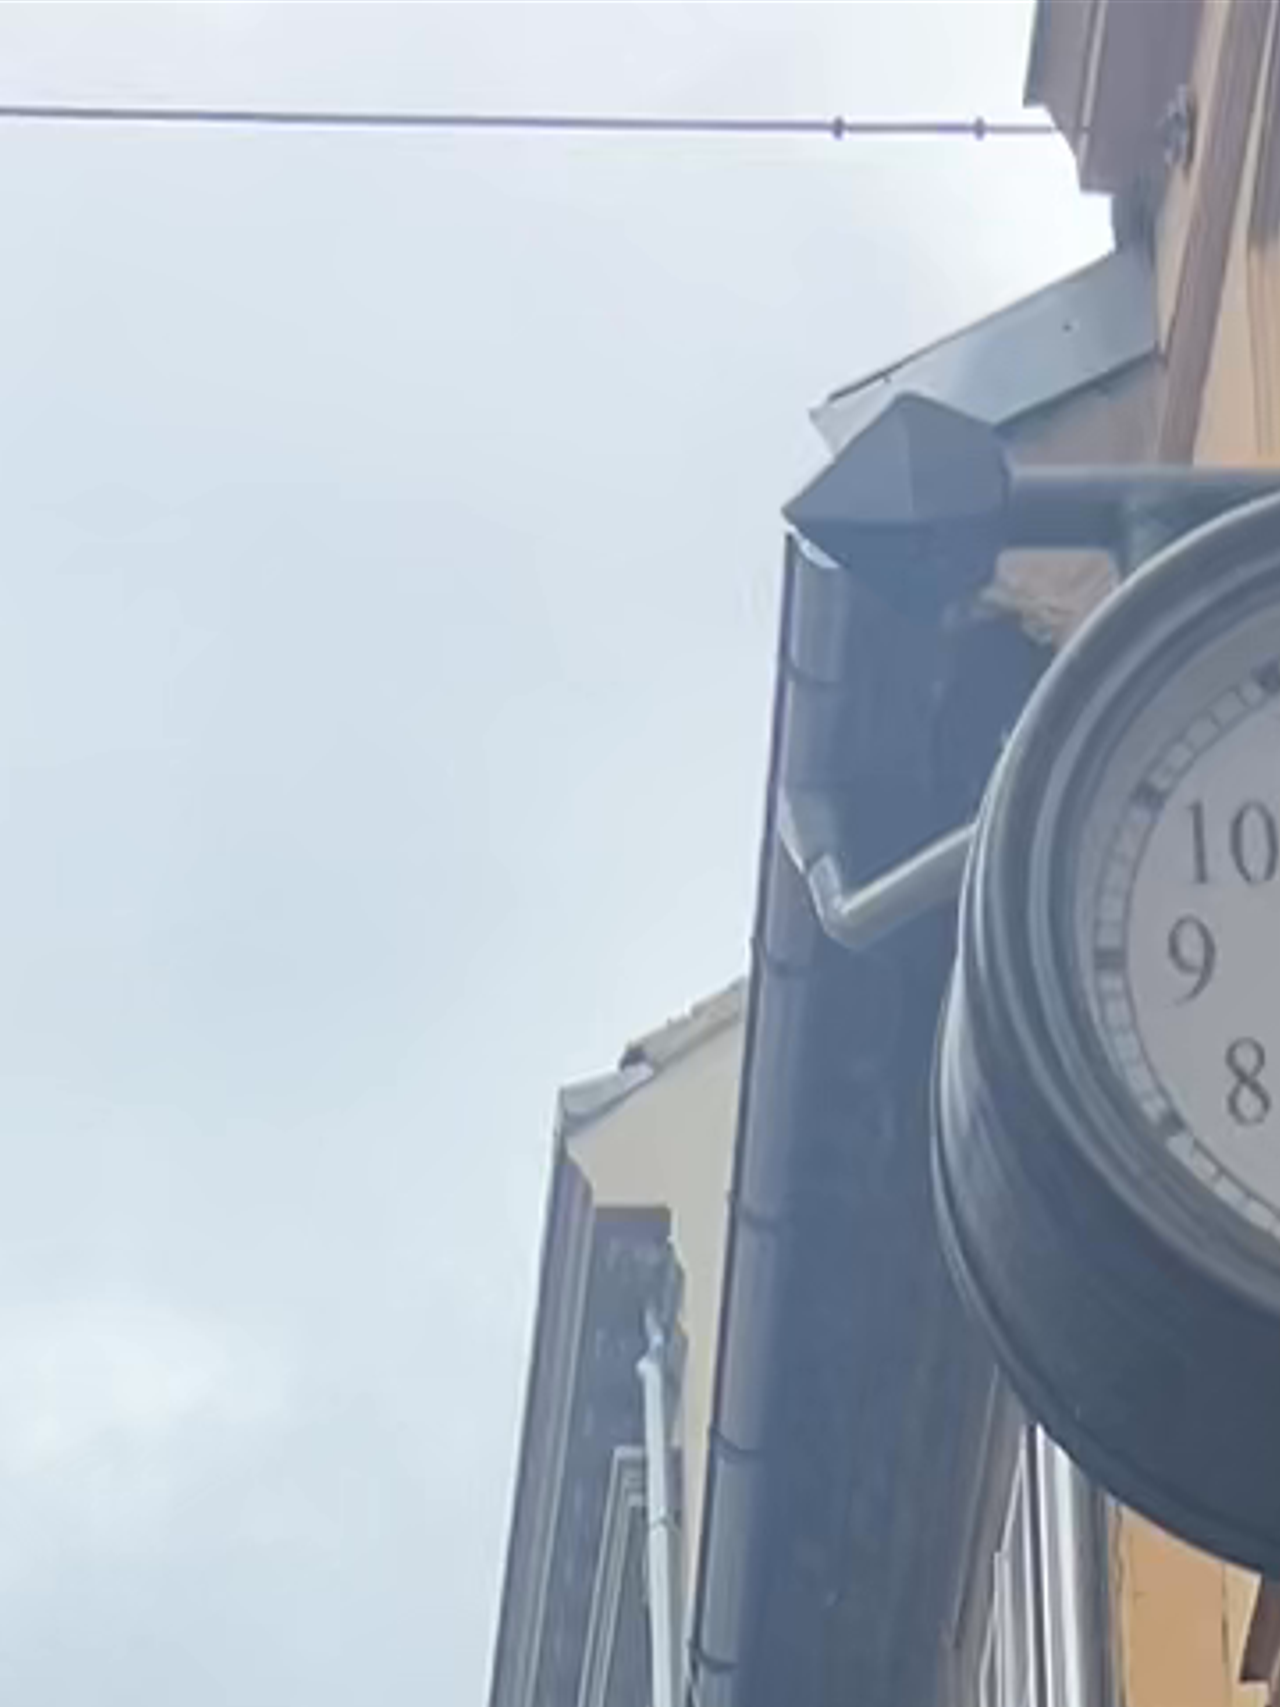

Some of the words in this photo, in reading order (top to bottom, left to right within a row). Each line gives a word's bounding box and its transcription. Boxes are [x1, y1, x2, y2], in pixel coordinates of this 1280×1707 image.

[1187, 799, 1279, 887] 10
[1166, 914, 1218, 1004] 9
[1222, 1036, 1273, 1126] 8
